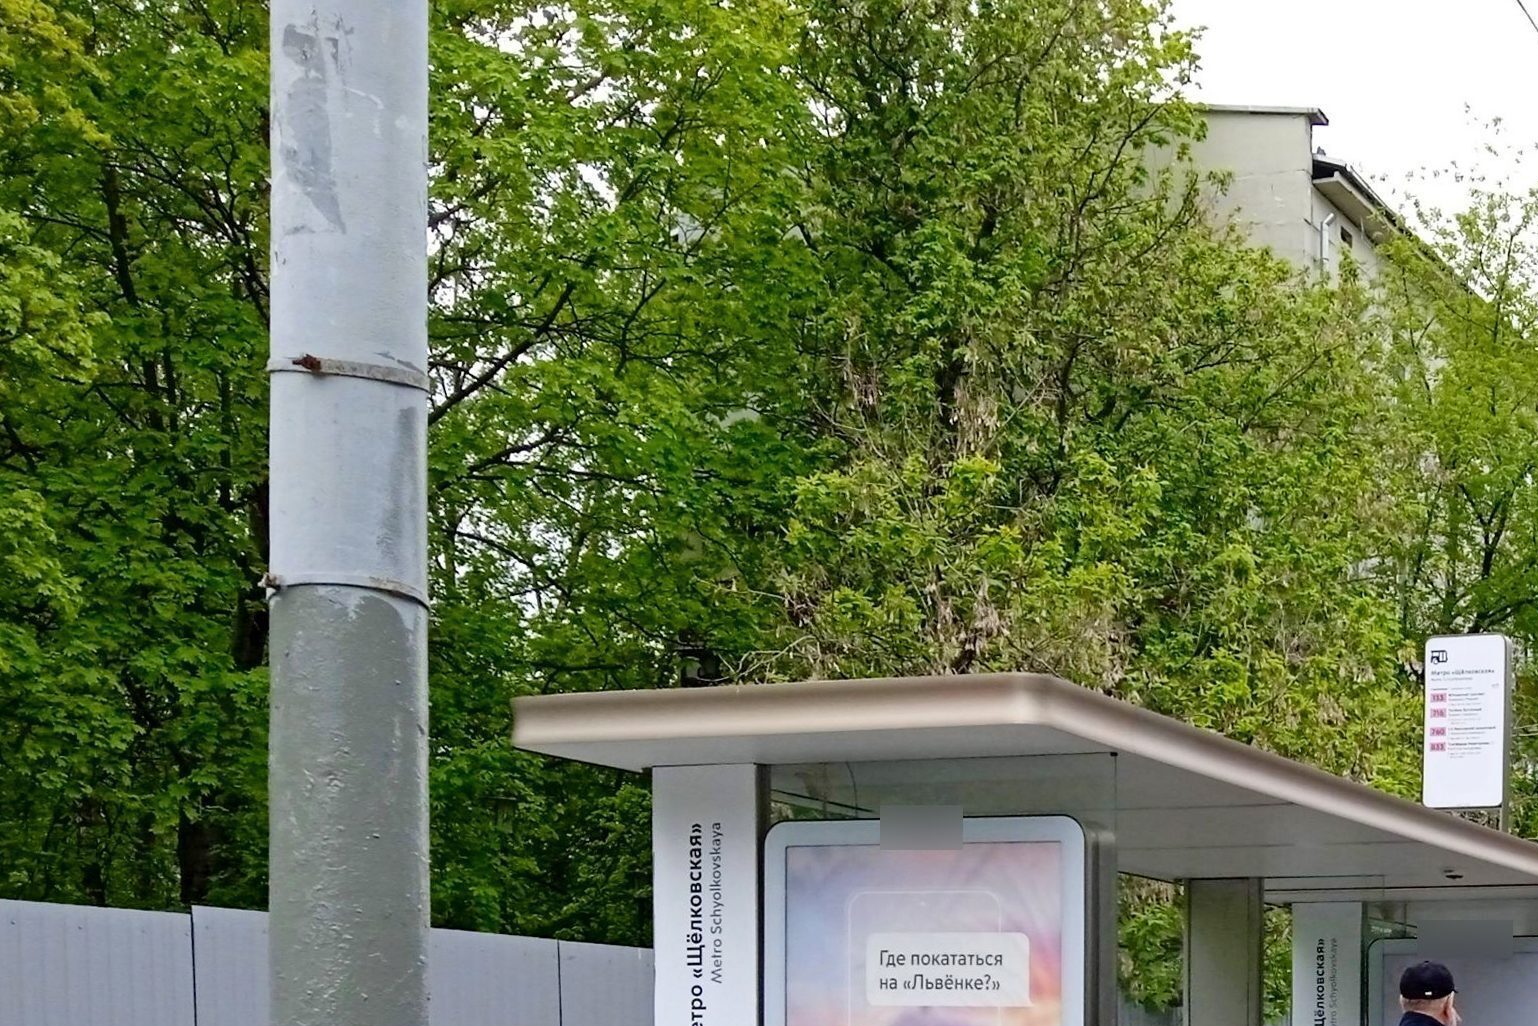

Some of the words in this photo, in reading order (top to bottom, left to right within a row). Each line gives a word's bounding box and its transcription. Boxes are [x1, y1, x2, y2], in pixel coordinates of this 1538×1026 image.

[686, 822, 706, 980] «Щёлковская»
[709, 822, 725, 934] Schyolkovskaya
[710, 938, 724, 984] Metro
[879, 949, 906, 968] Где
[910, 953, 1003, 967] покататься
[879, 977, 898, 990] на
[903, 973, 1001, 991] «Львёнке?»
[1328, 937, 1339, 1009] Schyolkovskaya
